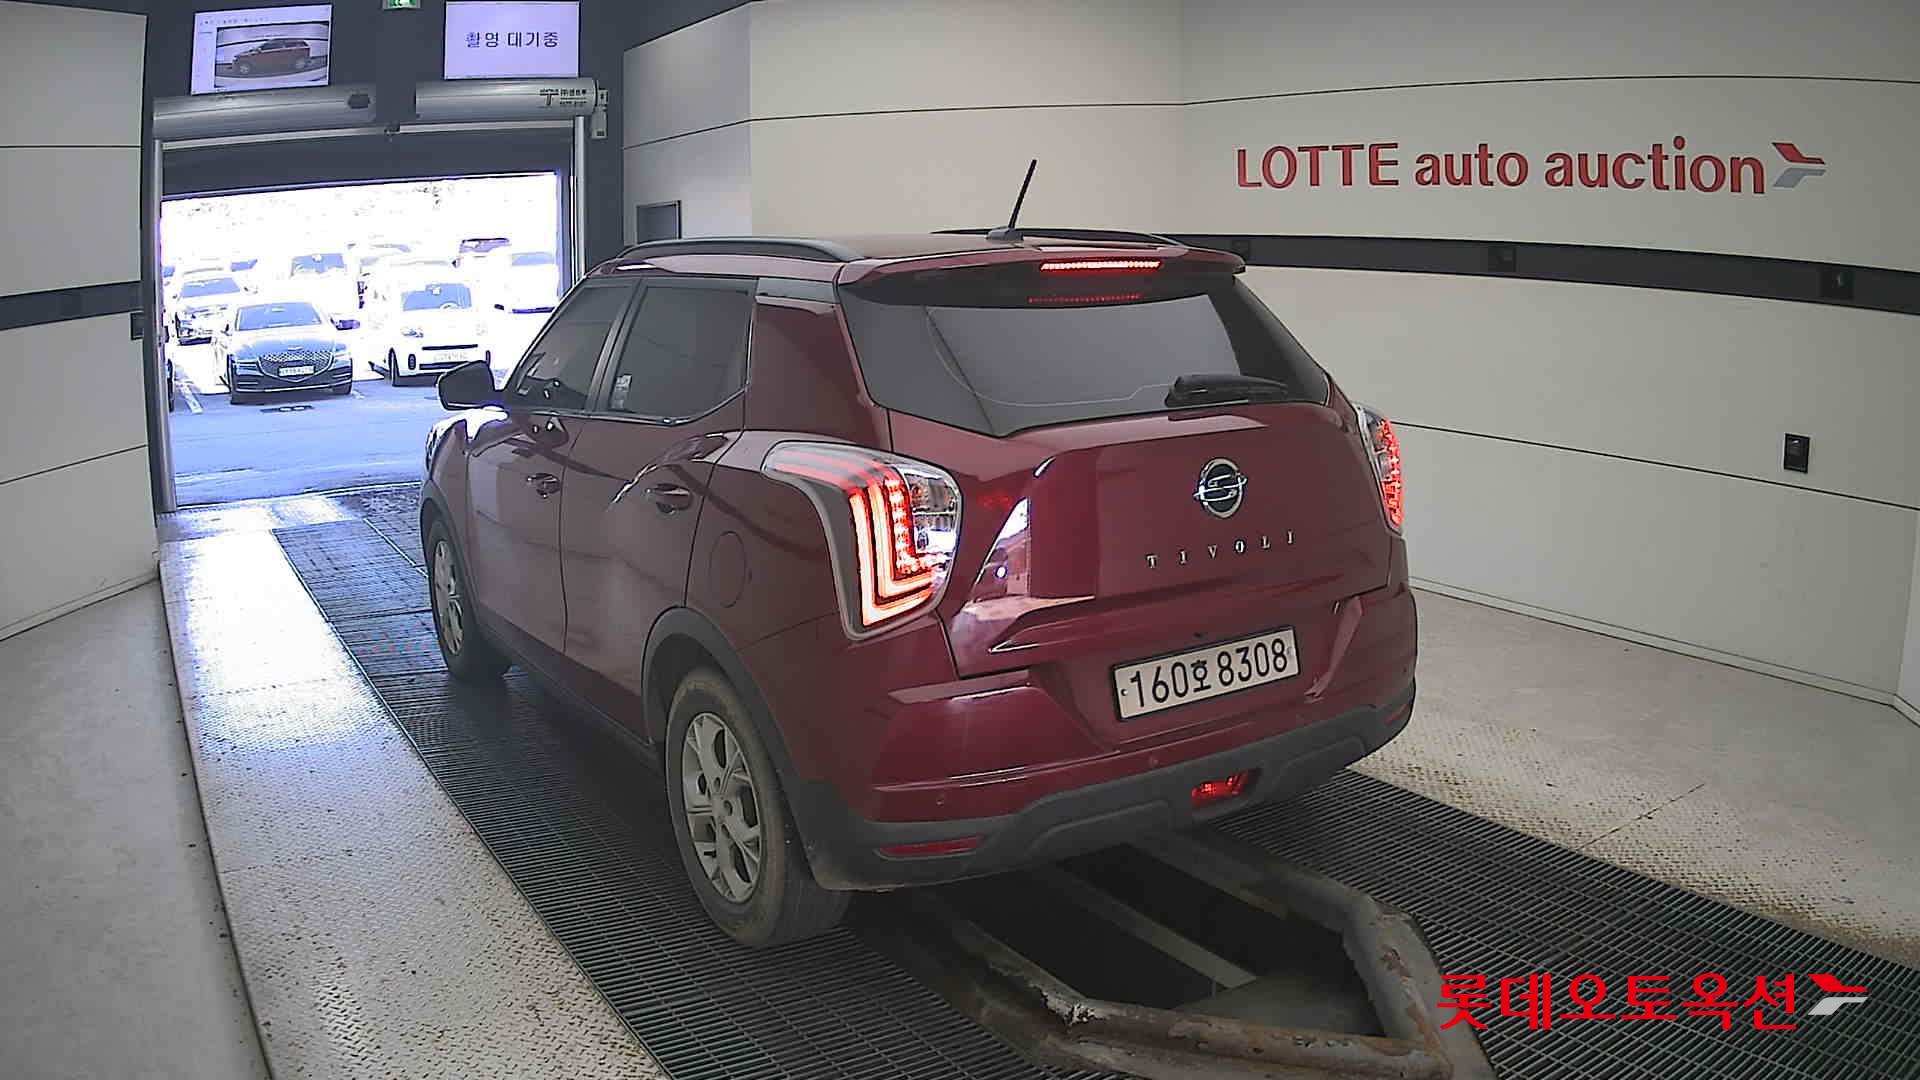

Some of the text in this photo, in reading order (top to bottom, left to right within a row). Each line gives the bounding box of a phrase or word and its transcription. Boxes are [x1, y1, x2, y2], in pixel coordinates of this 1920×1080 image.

[507, 31, 559, 48] 대기중
[1237, 135, 1766, 195] LOTTE auto auction
[1146, 530, 1296, 569] TIVOLI
